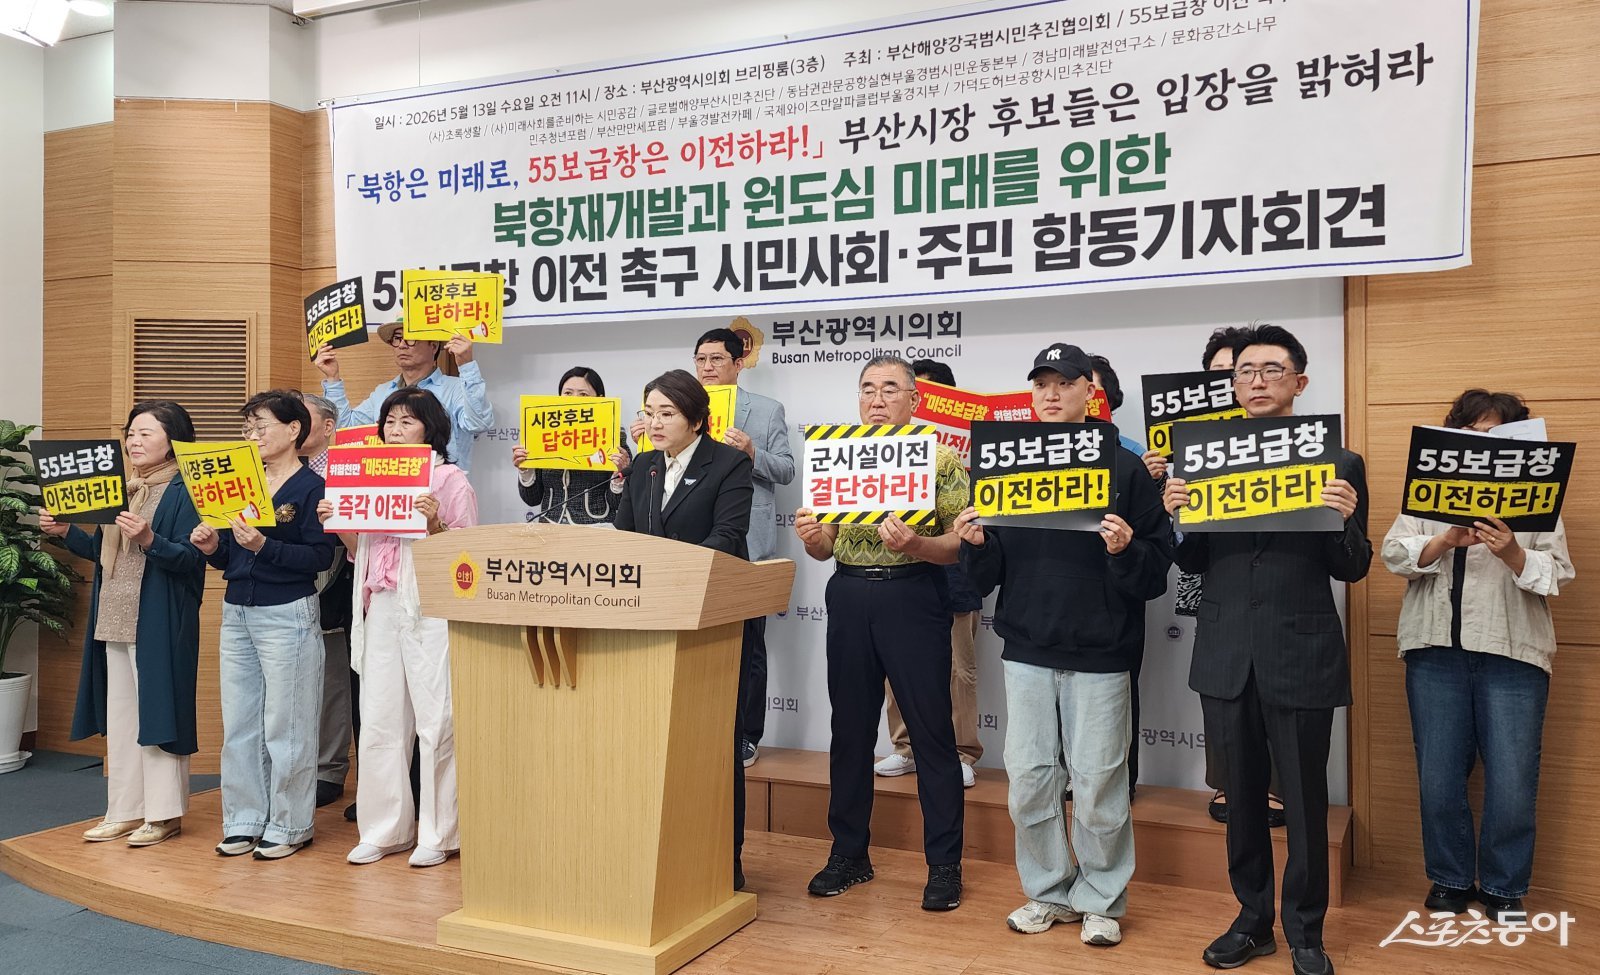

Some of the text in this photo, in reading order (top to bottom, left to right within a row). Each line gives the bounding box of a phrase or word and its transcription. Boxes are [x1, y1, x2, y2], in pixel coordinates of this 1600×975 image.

[375, 115, 395, 130] 일시
[406, 108, 447, 126] 2026년
[450, 105, 468, 120] 5월
[472, 101, 496, 117] 13일
[500, 96, 534, 114] 수요일
[538, 92, 562, 108] 오전
[566, 88, 591, 105] 11시
[604, 84, 628, 100] 장소
[640, 69, 730, 94] 부산광역시의회
[735, 54, 826, 82] 브리핑룸(3층)
[843, 49, 871, 68] 주최
[886, 12, 1110, 61] 부산해양강국범시민추진협의회
[1130, 0, 1206, 25] 55보급창
[428, 125, 481, 143] (사)초록생활
[490, 112, 594, 136] (사)미래사회를준비하는
[597, 107, 637, 122] 시민공감
[648, 88, 776, 116] 글로벌해양부산시민추진단
[786, 54, 1018, 98] 동남권관문공항실현부울경범시민운동본부
[1032, 34, 1156, 65] 경남미래발전연구소
[1172, 16, 1278, 45] 문화공간소나무
[529, 128, 586, 146] 민주청년포럼
[596, 118, 667, 138] 부산만만세포럼
[678, 108, 752, 129] 부울경발전카페
[764, 83, 940, 118] 국제와이즈만알파클럽부울경지부
[954, 59, 1112, 94] 가덕도허브공항시민추진단
[346, 42, 1434, 204] 「북항은 미래로, 55보급창은 이전하라!」 부산시장 후보들은 입장을 밝혀라
[494, 131, 1172, 248] 북항재개발과 원도심 미래를 위한
[532, 252, 608, 304] 이전
[620, 246, 698, 299] 촉구
[1032, 184, 1386, 272] 합동기자회견
[307, 281, 358, 326] 55보급창
[414, 282, 477, 302] 시장후보
[310, 308, 360, 348] 이전하라!
[425, 302, 490, 324] 답하라!
[772, 310, 962, 346] 부산광역시의회
[772, 344, 962, 364] Busan Metropolitan Council
[532, 409, 594, 428] 시장후보
[994, 408, 1032, 422] 위험천만
[542, 428, 607, 452] 답하라!
[810, 440, 928, 472] 군시설이전
[979, 428, 1104, 470] 55보급창
[1183, 420, 1328, 473] 55보급창
[38, 444, 114, 479] 55보급창
[184, 454, 234, 482] 시장후보
[330, 464, 360, 476] 위험천만
[1416, 446, 1560, 478] 55보급창
[46, 480, 120, 512] 이전하라!
[192, 477, 256, 508] 답하라!
[810, 473, 928, 506] 결단하라!
[979, 473, 1104, 512] 이전하라!
[1188, 475, 1328, 517] 이전하라!
[1414, 482, 1554, 516] 이전하라!
[338, 494, 413, 520] 즉각 이전!
[486, 557, 642, 588] 부산광역시의회
[487, 588, 640, 608] Busan Metropolitan Council
